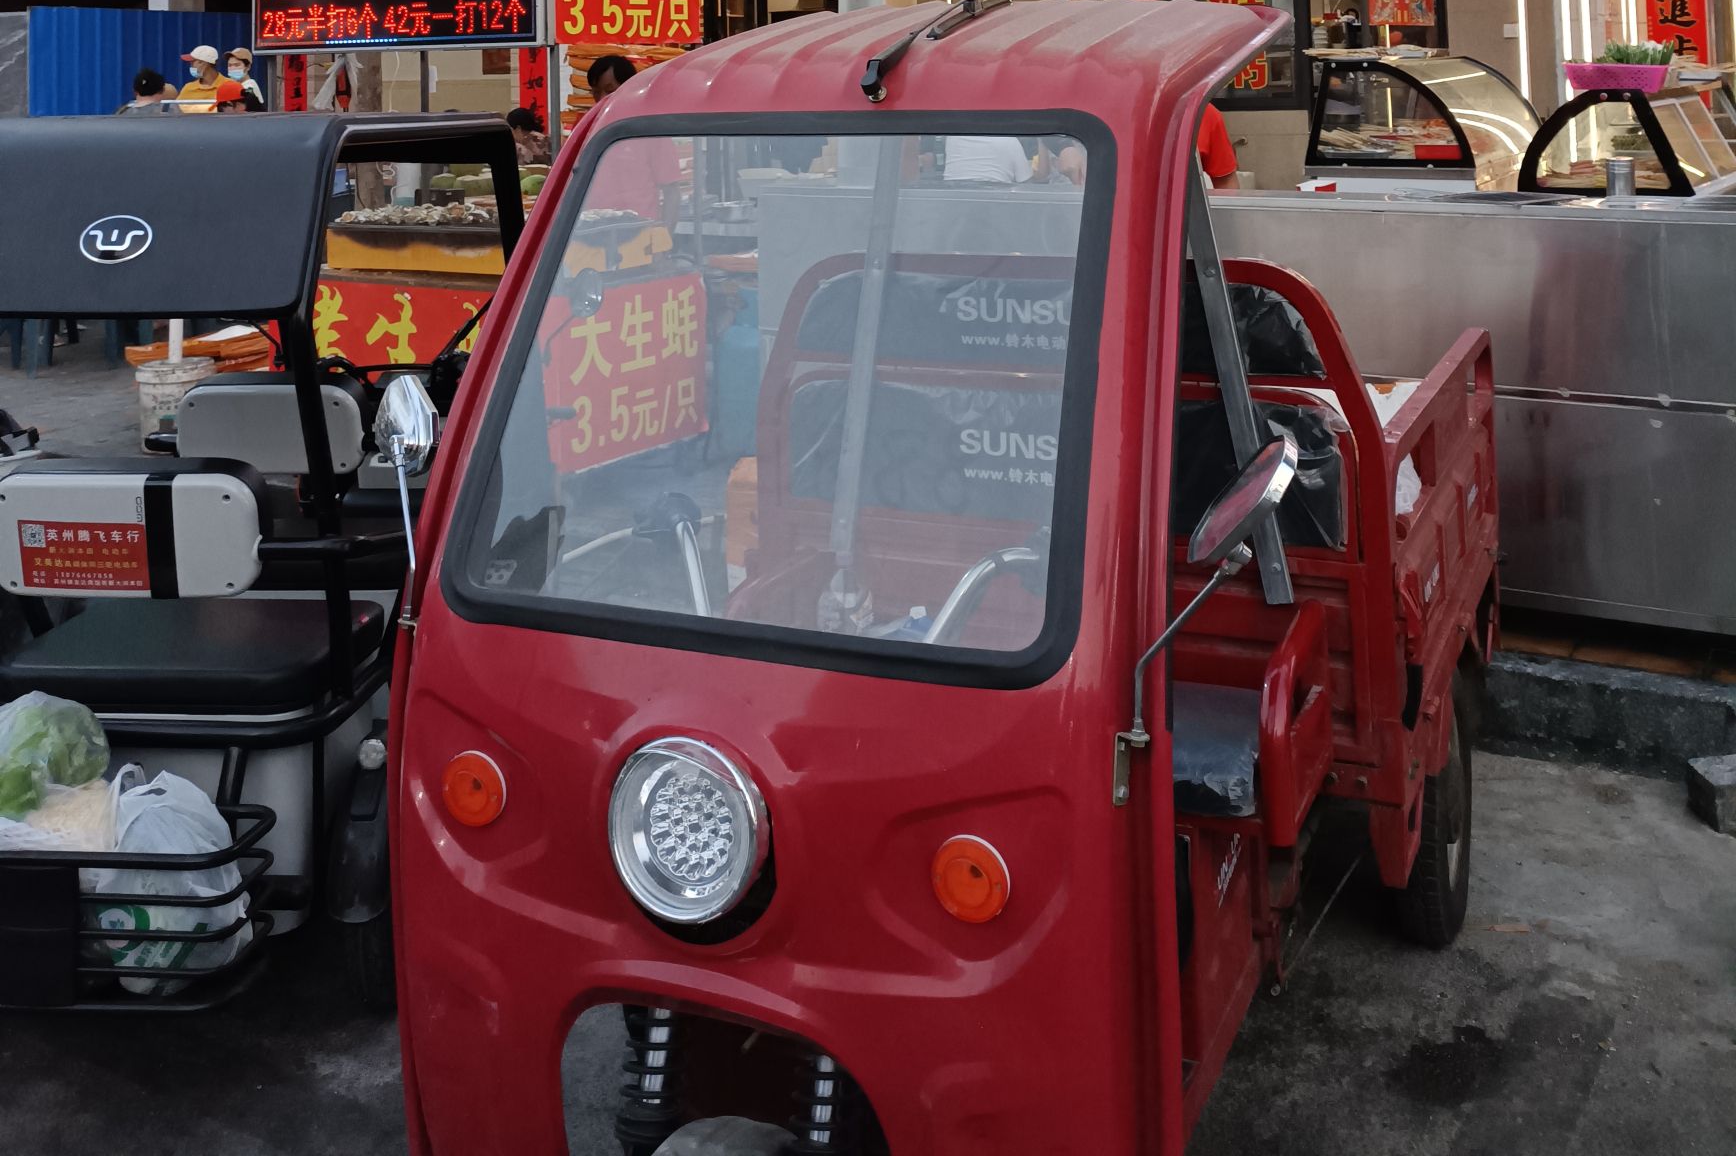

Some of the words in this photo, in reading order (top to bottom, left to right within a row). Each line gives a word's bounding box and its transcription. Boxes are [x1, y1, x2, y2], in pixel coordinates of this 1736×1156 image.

[262, 1, 378, 39] 28元半打6个
[569, 285, 699, 387] 大生蚝
[570, 377, 699, 455] 3.5元/只
[46, 528, 140, 543] 英州腾飞车行
